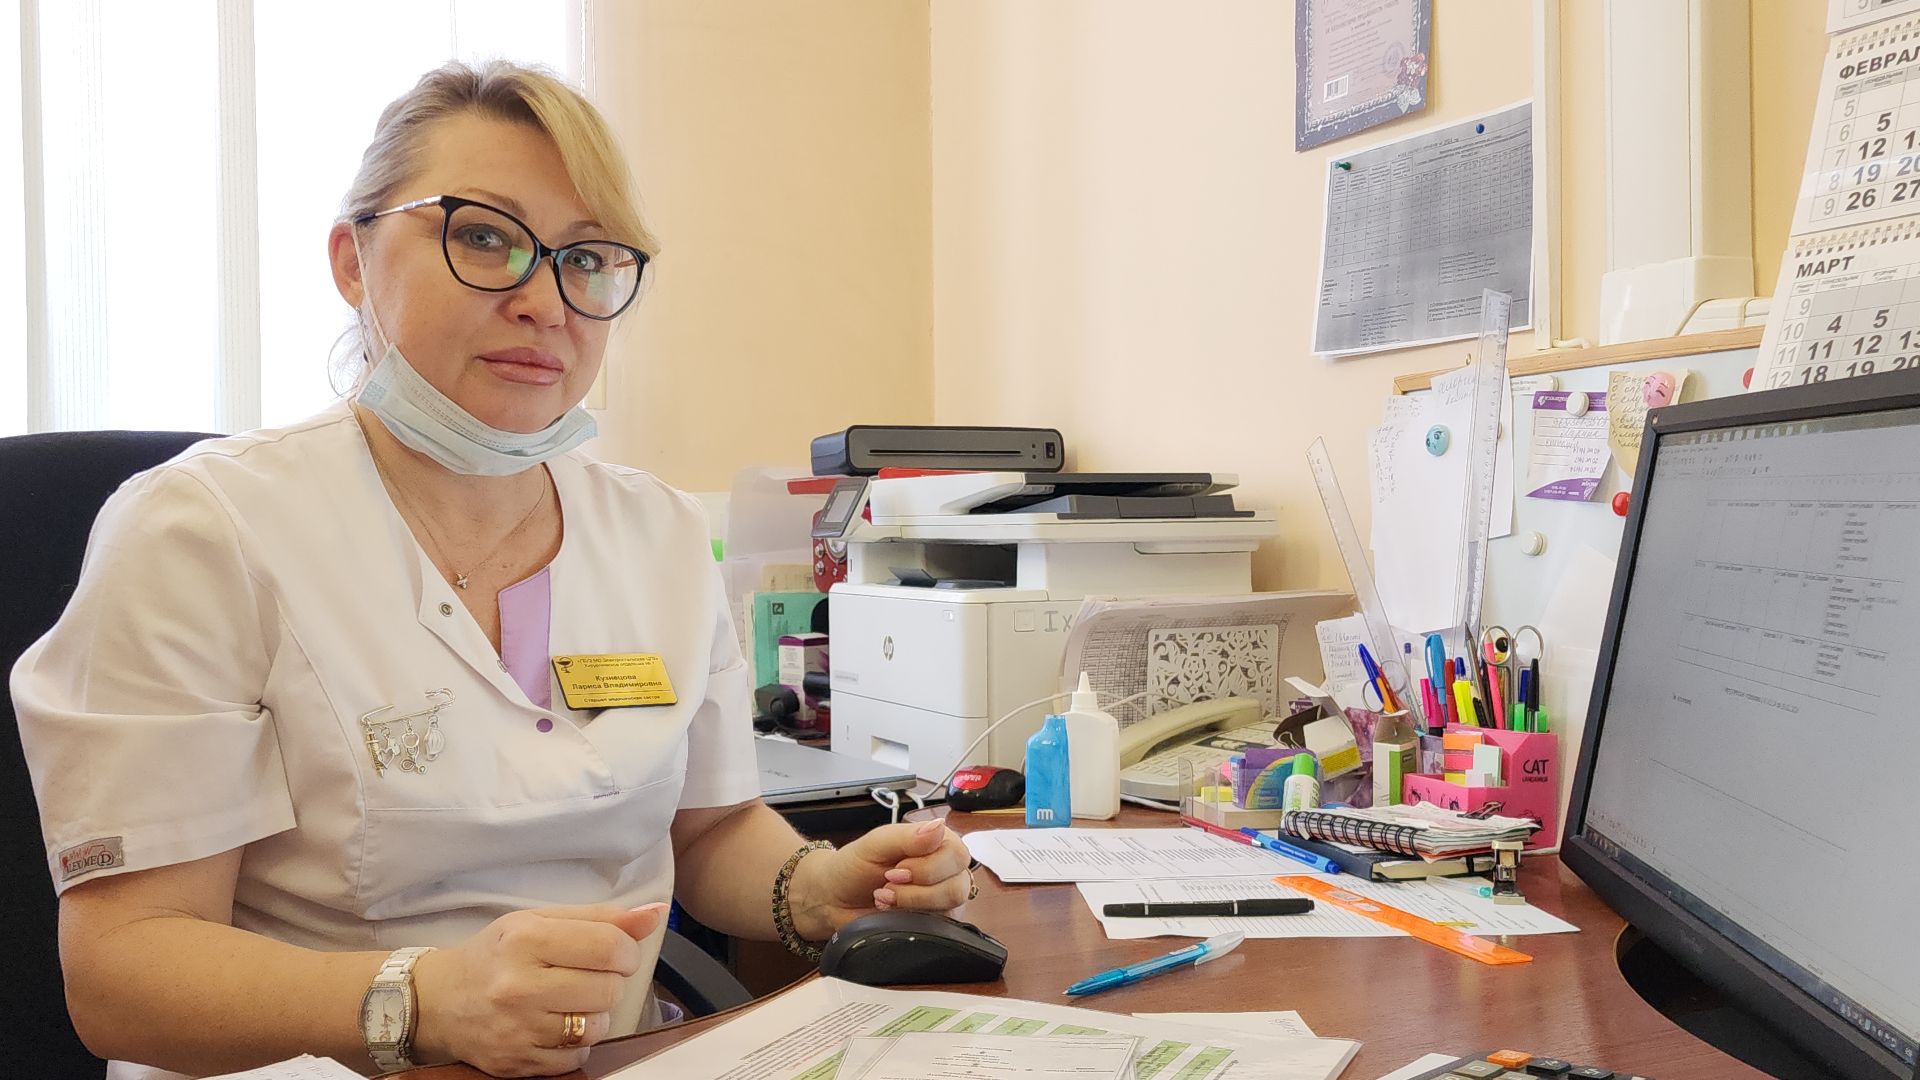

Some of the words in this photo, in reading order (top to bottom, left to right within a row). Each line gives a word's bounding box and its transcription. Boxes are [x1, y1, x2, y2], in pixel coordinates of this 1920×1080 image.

[1844, 100, 1854, 117] 5
[1840, 124, 1850, 142] 6
[1877, 112, 1892, 132] 5
[1835, 149, 1845, 166] 7
[1858, 138, 1887, 160] 12
[1904, 130, 1920, 150] 1
[1829, 173, 1840, 191] 8
[1853, 163, 1880, 185] 19
[1823, 198, 1835, 216] 9
[1845, 188, 1876, 211] 26
[1891, 179, 1920, 203] 27
[1796, 255, 1855, 279] МАРТ
[1800, 298, 1811, 315] 9
[1784, 322, 1804, 341] 10
[1827, 315, 1842, 333] 4
[1873, 309, 1890, 328] 5
[1777, 346, 1797, 365] 11
[1808, 340, 1834, 361] 11
[1853, 335, 1882, 356] 12
[1769, 370, 1791, 389] 12
[1801, 365, 1828, 385] 18
[1846, 360, 1875, 378] 19
[572, 683, 602, 691] Лариса
[604, 681, 663, 690] Владимировна
[595, 674, 637, 682] Кузнецова
[1522, 759, 1550, 775] CAT
[1036, 808, 1054, 821] m
